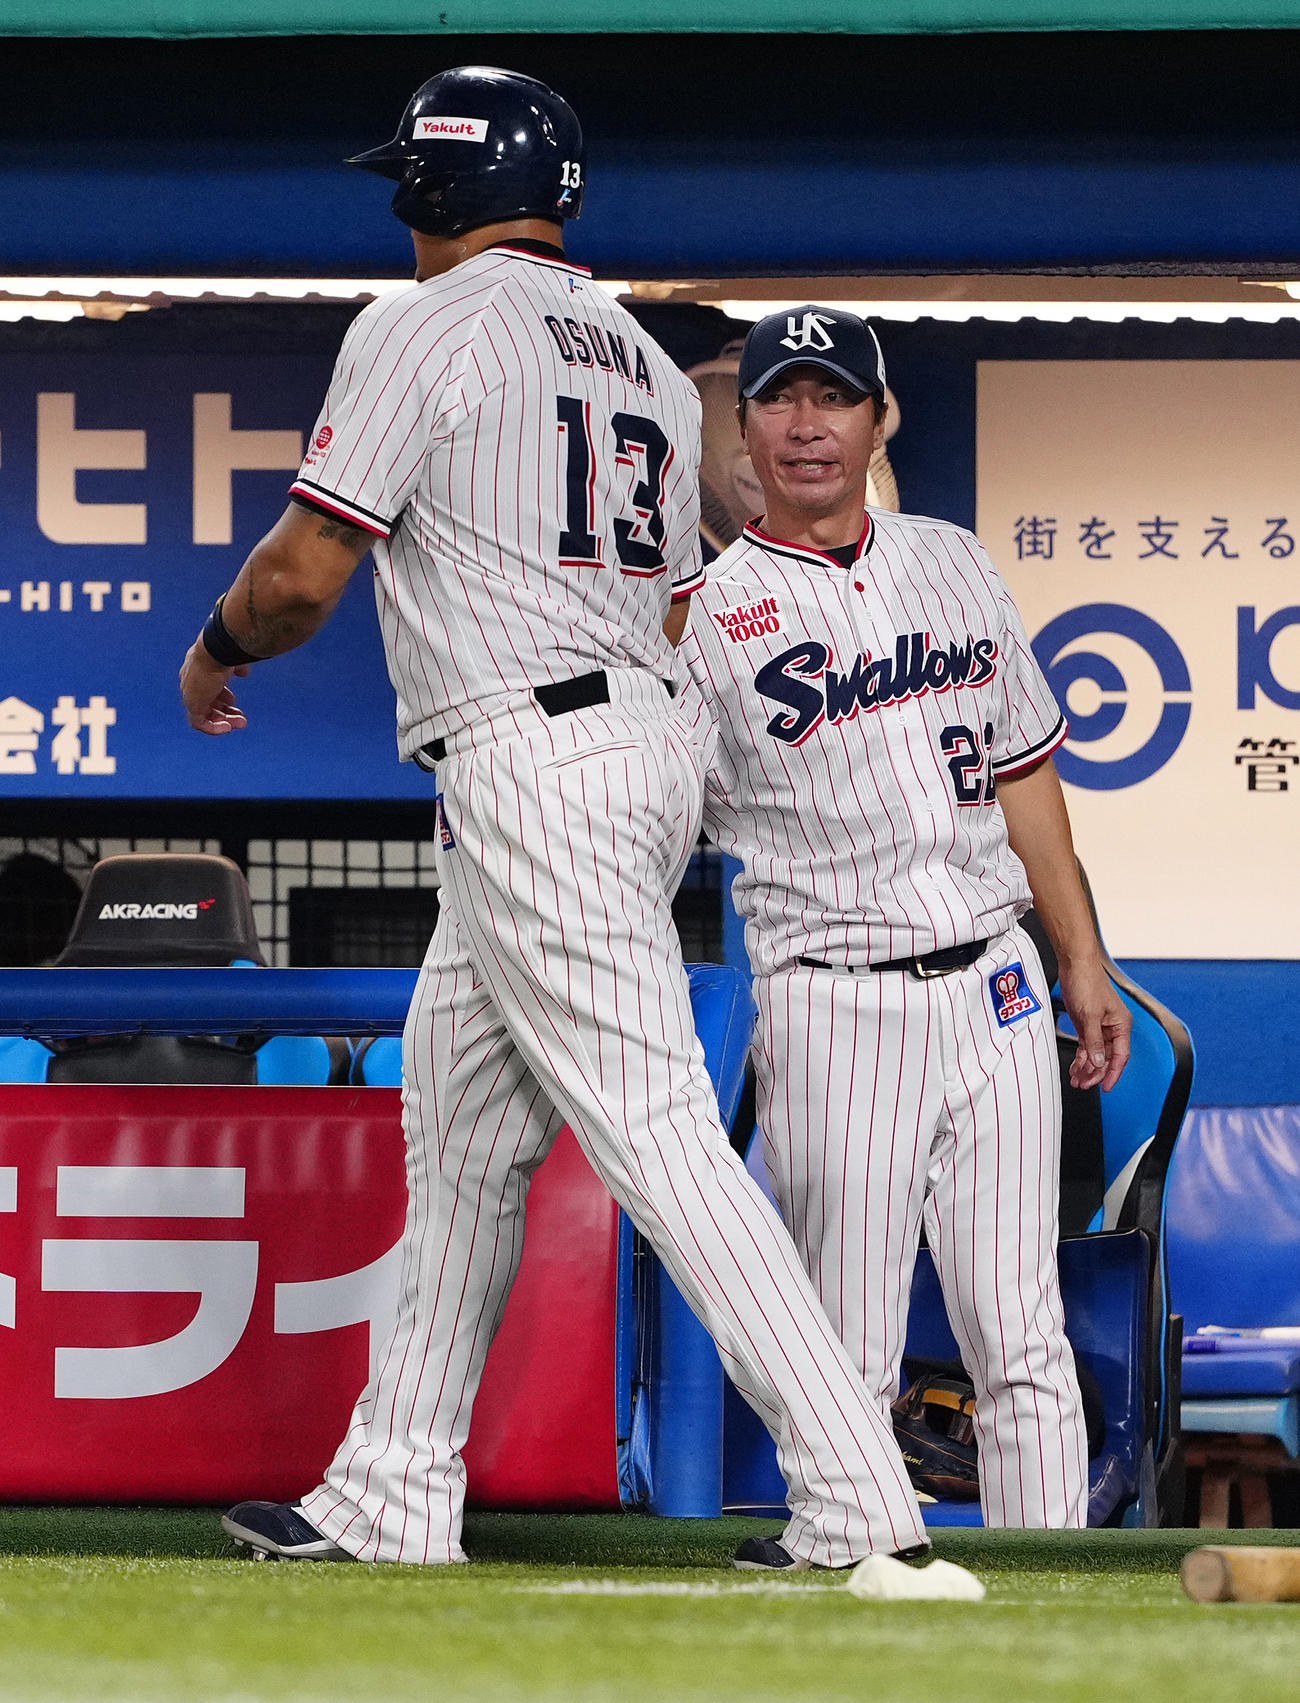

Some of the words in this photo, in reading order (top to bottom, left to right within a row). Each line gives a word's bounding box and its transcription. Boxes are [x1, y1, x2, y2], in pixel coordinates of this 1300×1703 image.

[423, 122, 476, 135] Yakult
[560, 160, 581, 189] 13
[545, 315, 654, 397] OSUNA
[0, 392, 303, 545] ヒト
[556, 395, 674, 579] 13
[1014, 515, 1295, 560] 街を支える
[713, 597, 780, 628] Yakult
[725, 616, 780, 643] 1000
[754, 631, 998, 748] Swallows
[99, 903, 198, 919] AKRACING
[0, 1165, 405, 1399] ライ
